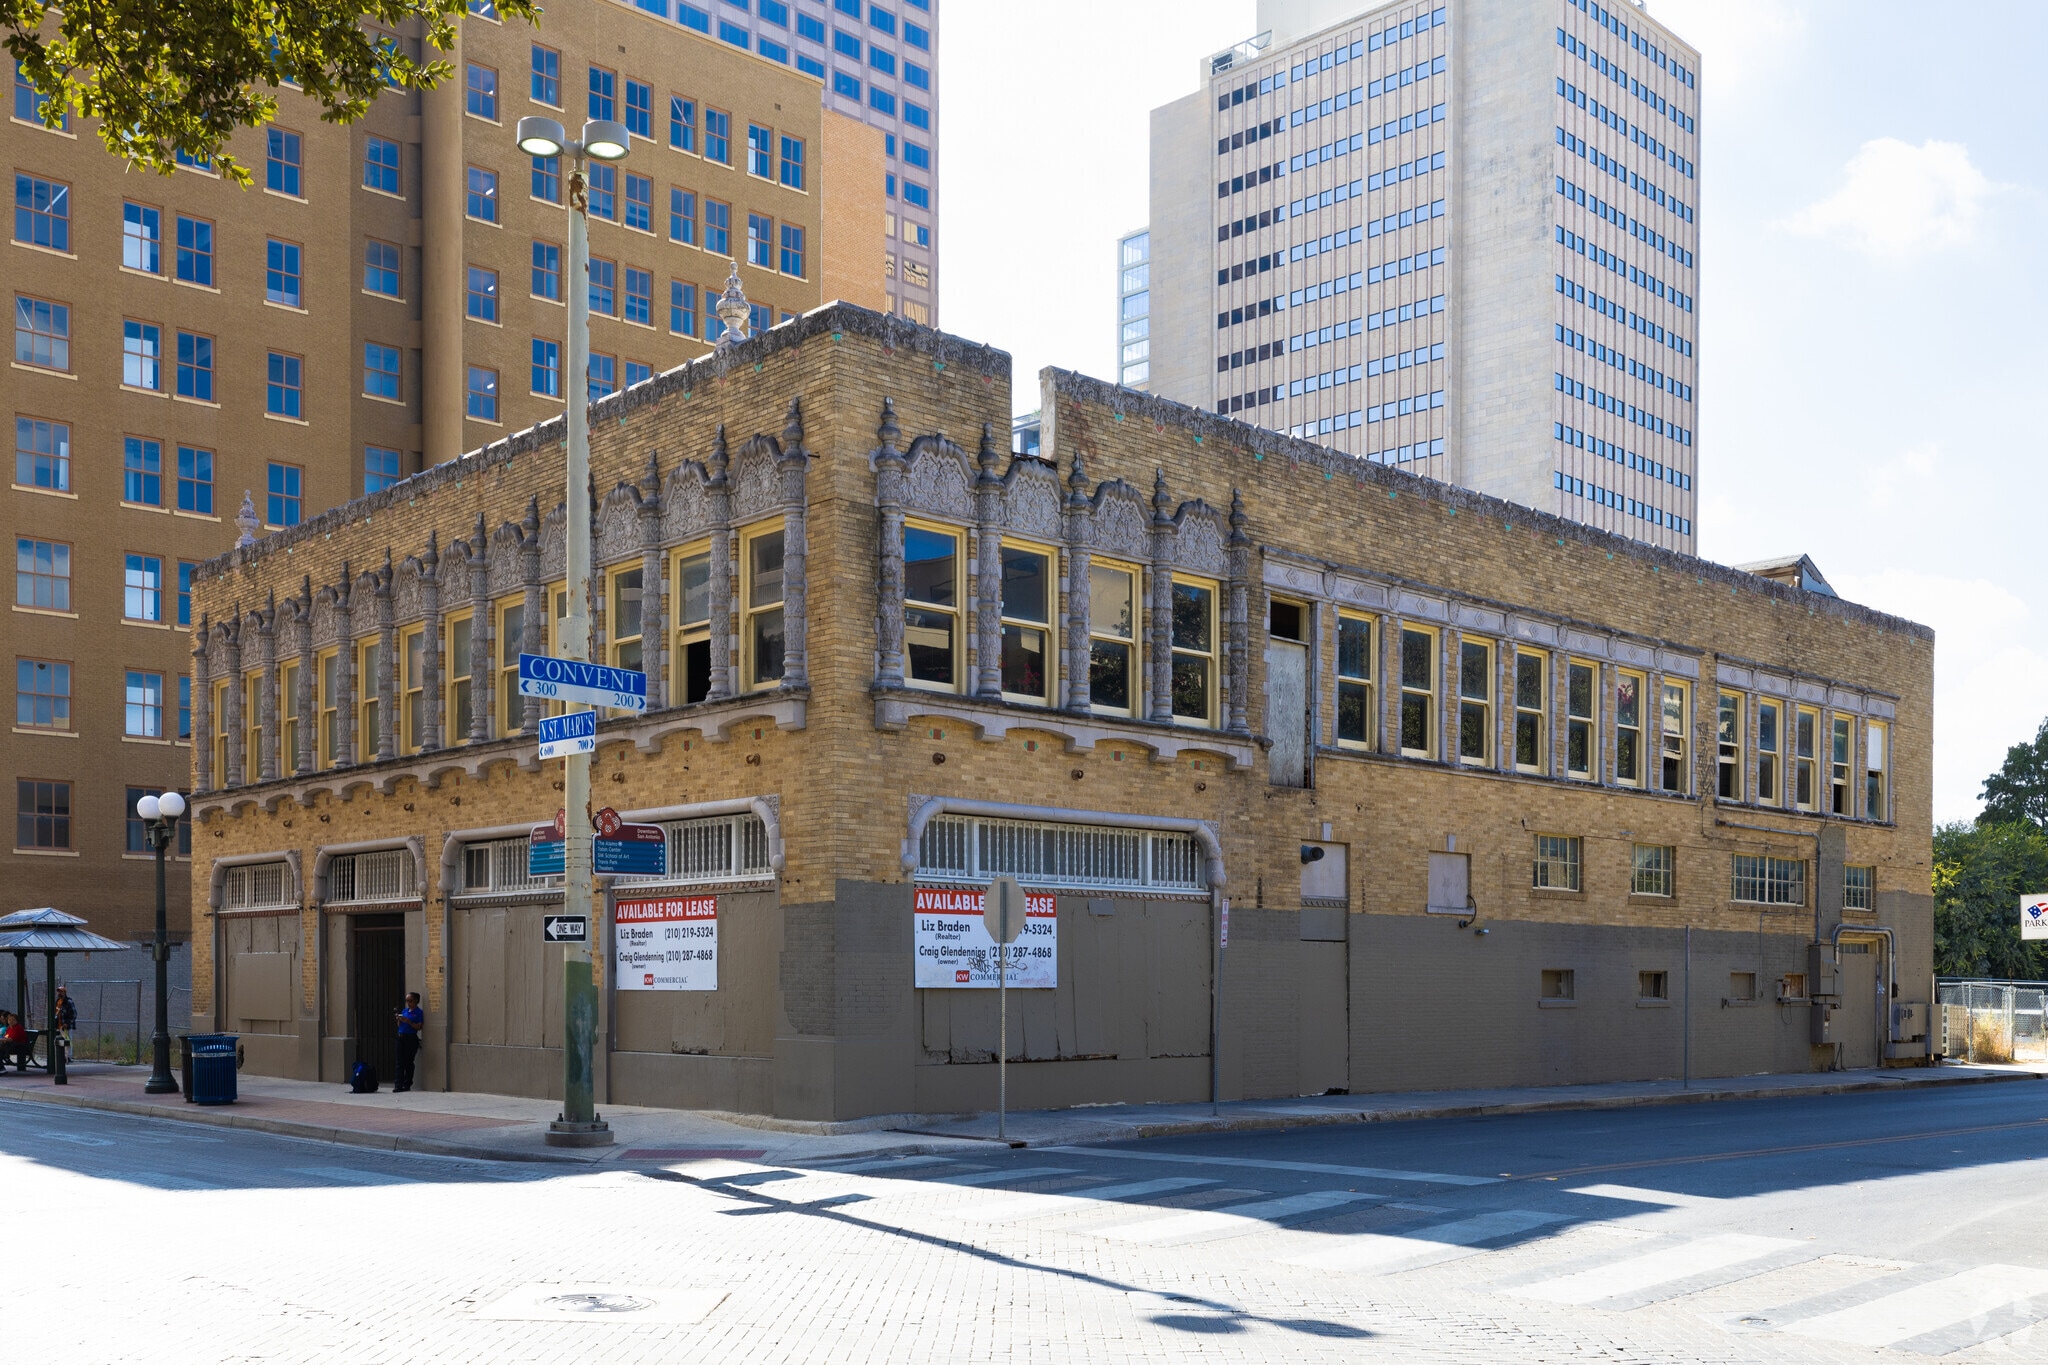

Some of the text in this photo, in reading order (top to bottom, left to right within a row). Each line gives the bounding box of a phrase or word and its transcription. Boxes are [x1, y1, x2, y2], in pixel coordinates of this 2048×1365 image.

[529, 657, 639, 693] CONVENT
[534, 682, 634, 708] 300 200
[540, 713, 593, 742] N ST. MARY'S
[544, 740, 589, 756] 600 700
[617, 899, 715, 920] AVAILABLE FOR LEASE
[917, 892, 1054, 914] AVAILABLE EASE
[556, 923, 583, 934] ONE WAY
[922, 920, 935, 932] Liz
[938, 920, 970, 932] Braden
[620, 927, 714, 941] Liz Braden (210) 219-5324
[935, 933, 961, 941] (Realtor)
[619, 950, 713, 964] Craig Glendenning (210) 287-4868
[920, 946, 939, 959] Craig
[941, 946, 986, 960] Glendenning
[1013, 947, 1052, 958] 287-4868
[654, 976, 688, 984] COMMERCIAL
[956, 973, 1018, 981] KW COMMERIAL
